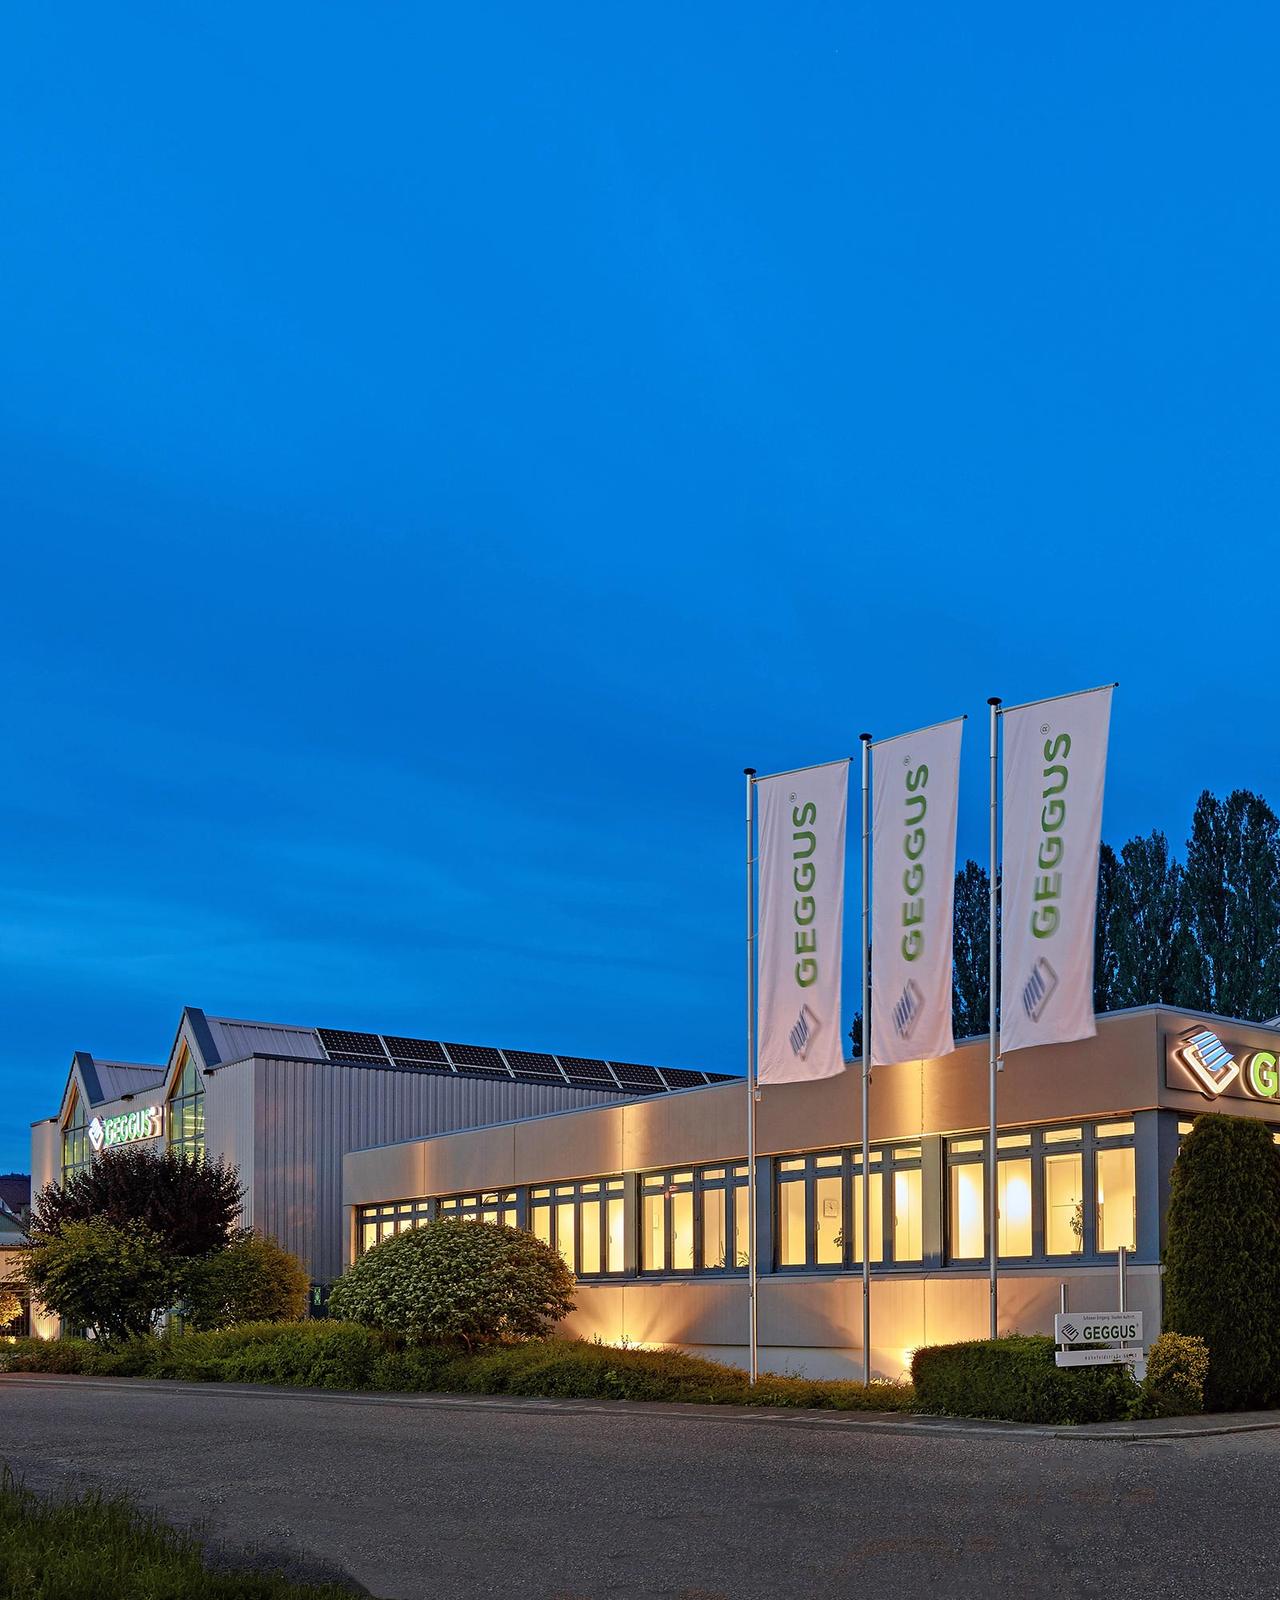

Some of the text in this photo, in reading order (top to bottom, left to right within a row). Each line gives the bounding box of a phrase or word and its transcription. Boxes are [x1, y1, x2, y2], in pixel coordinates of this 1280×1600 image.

[792, 801, 818, 988] GEGGUS
[901, 764, 929, 962] GEGGUS
[1032, 733, 1072, 939] GEGGUS
[104, 1108, 152, 1146] GEGGUS
[1083, 1324, 1136, 1340] GEGGUS
